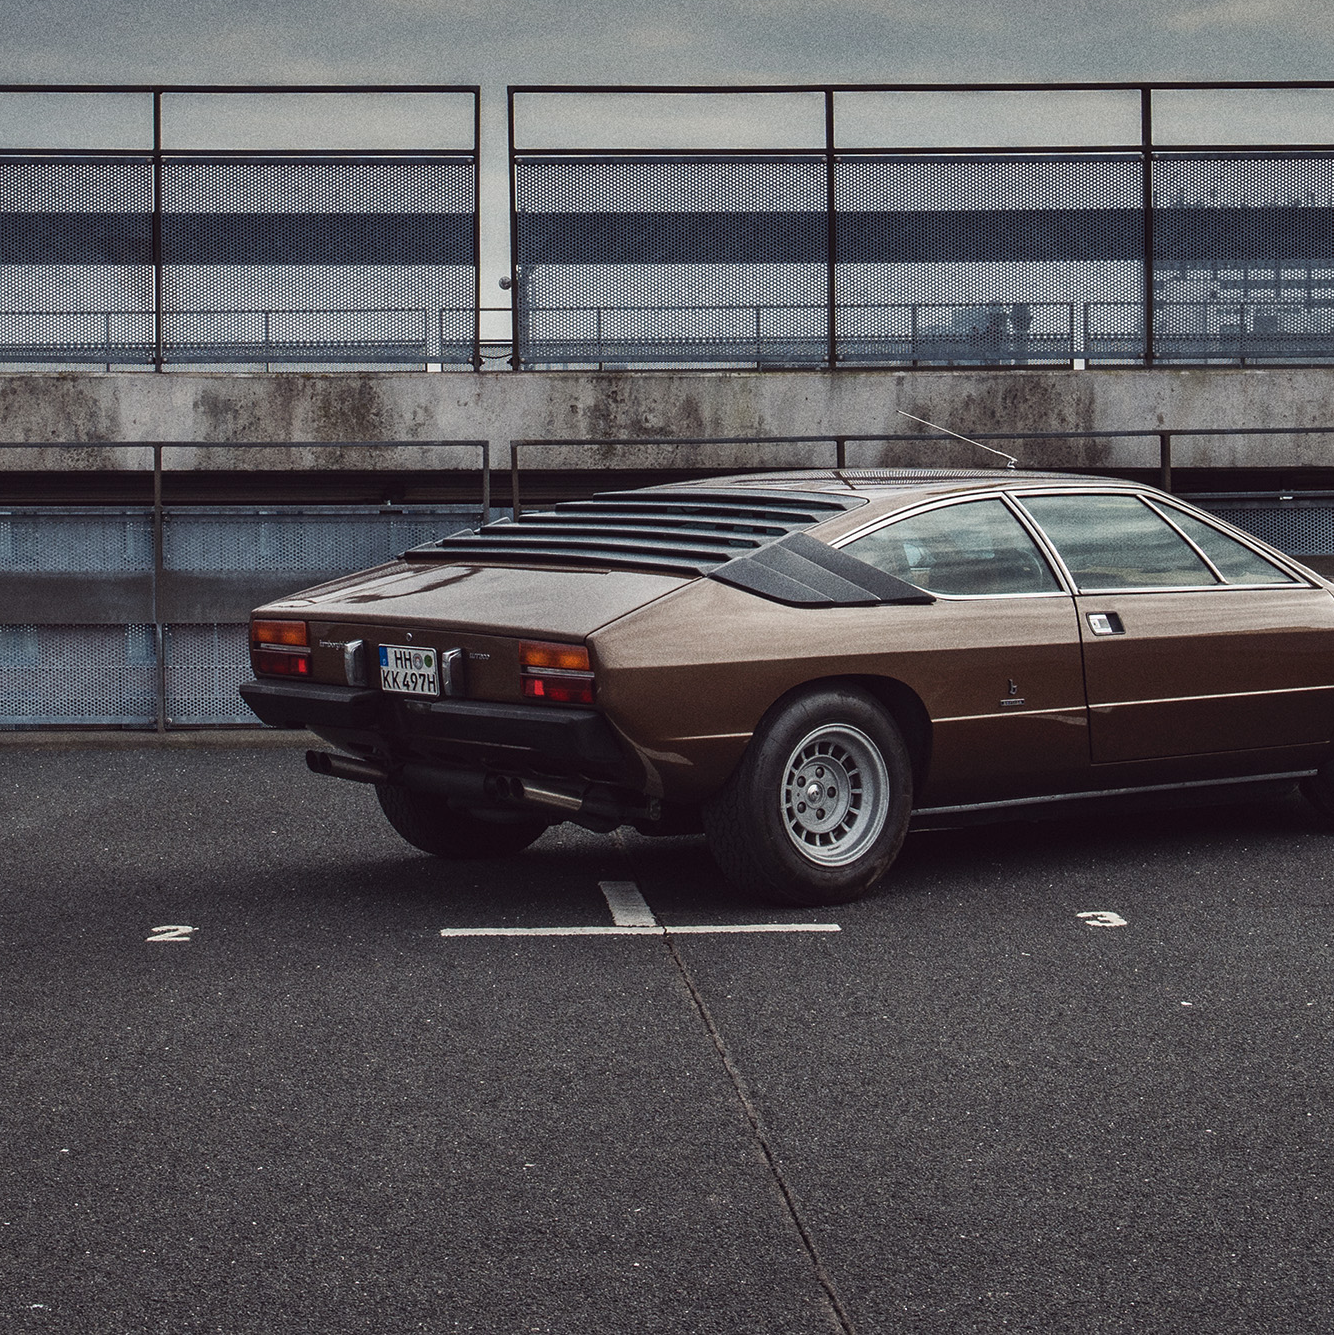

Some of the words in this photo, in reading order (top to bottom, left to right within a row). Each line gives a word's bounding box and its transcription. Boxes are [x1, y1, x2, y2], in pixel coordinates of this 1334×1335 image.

[394, 650, 413, 669] HH
[1076, 911, 1128, 927] 3
[145, 925, 194, 942] 2
